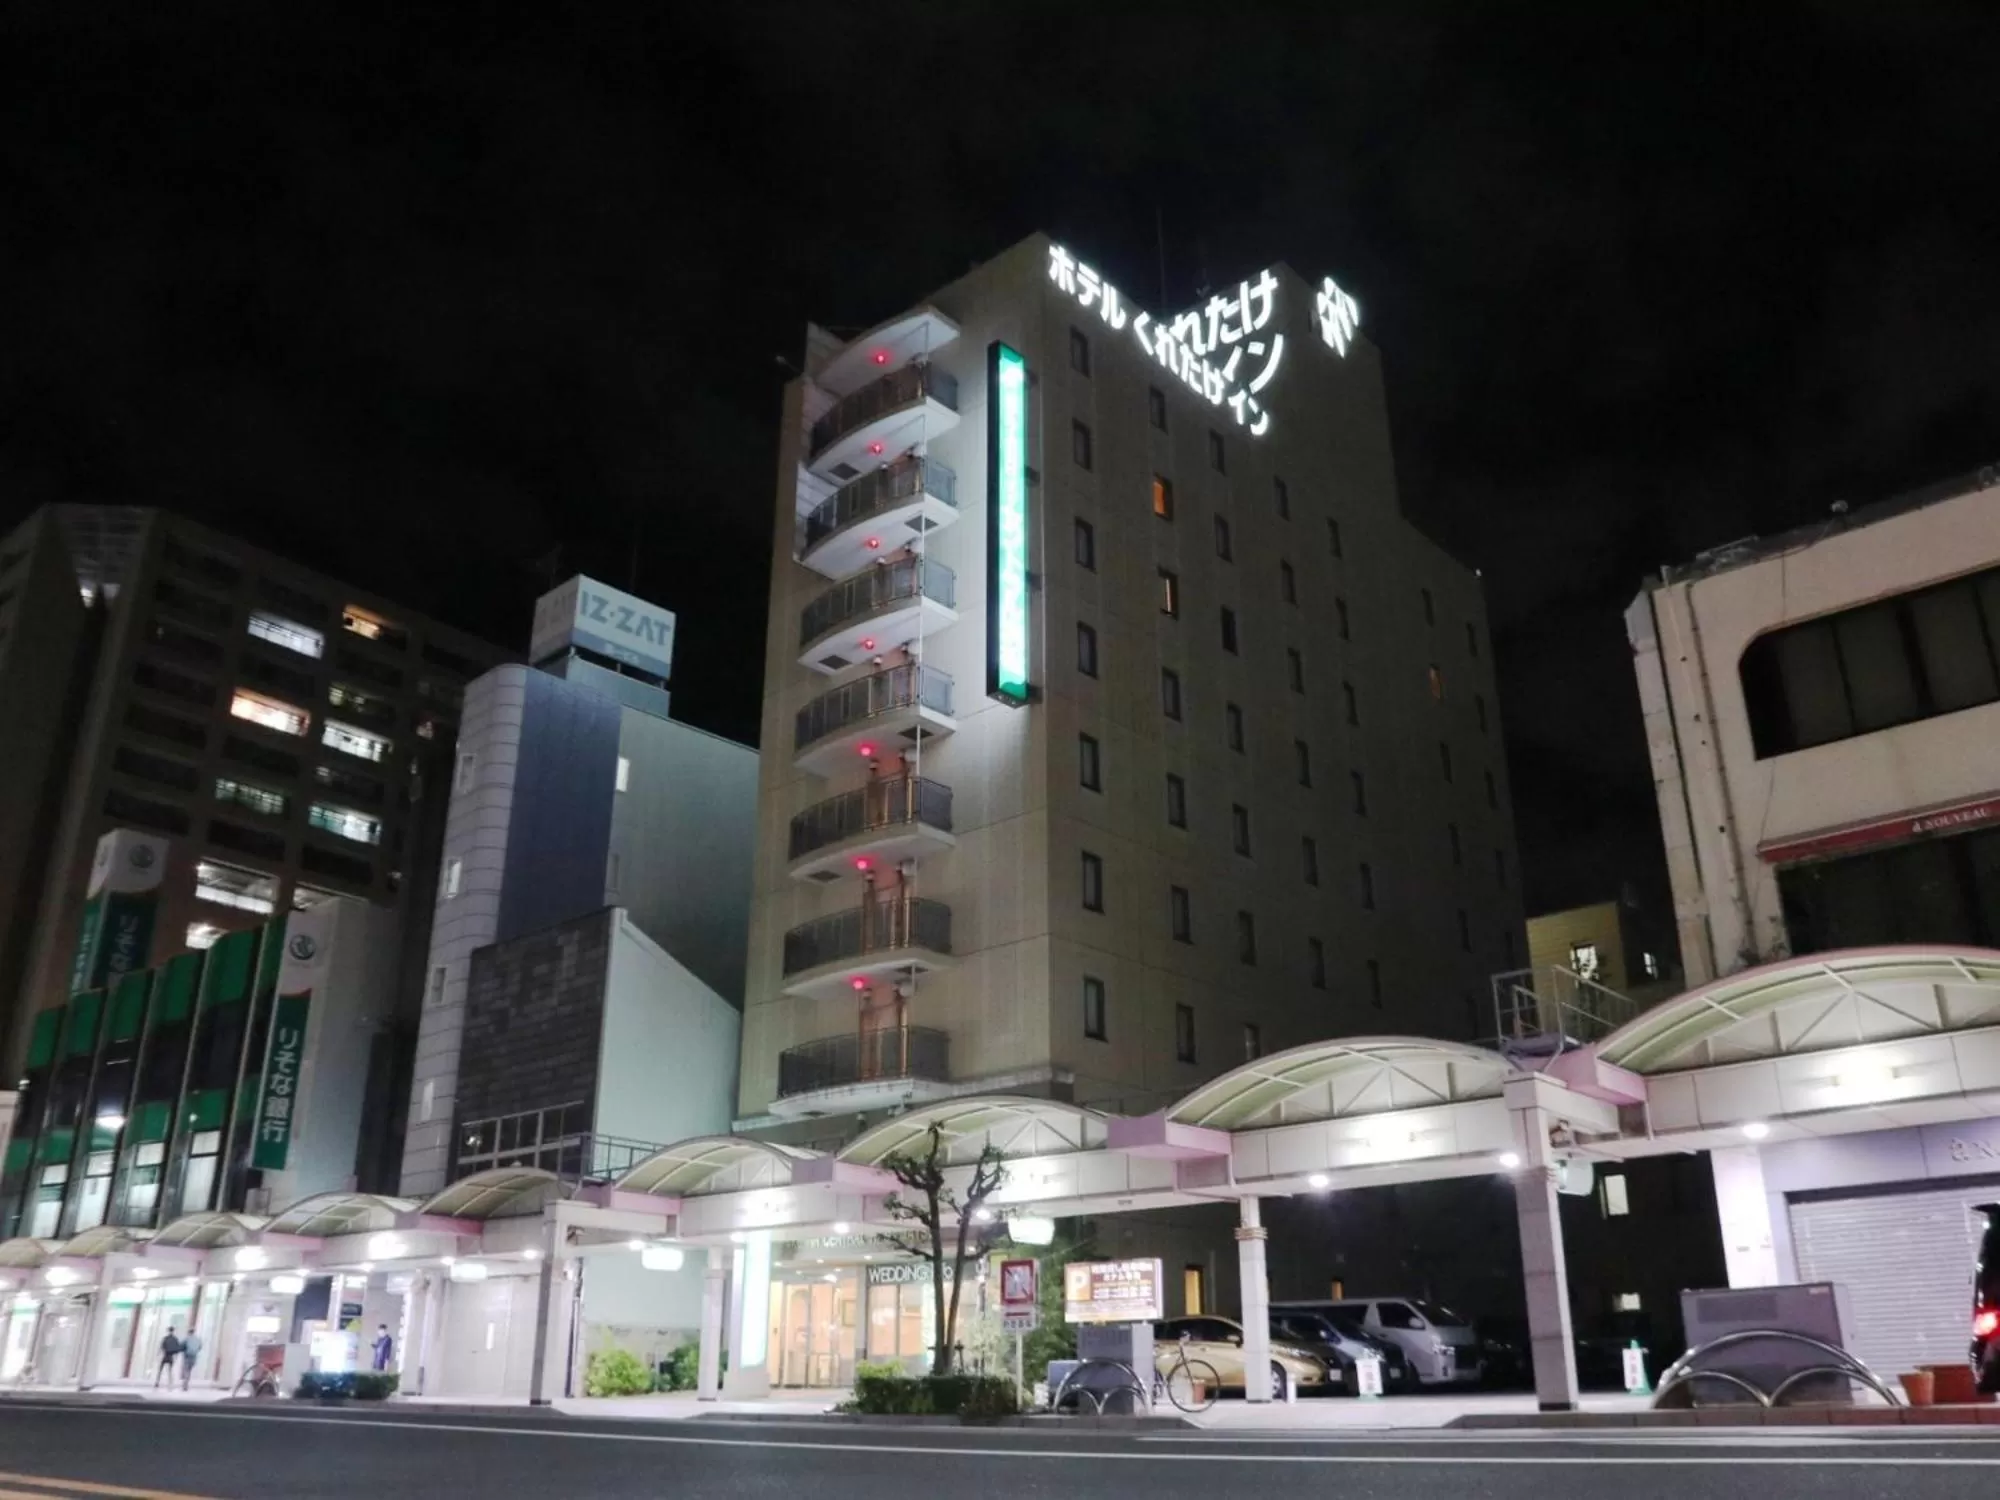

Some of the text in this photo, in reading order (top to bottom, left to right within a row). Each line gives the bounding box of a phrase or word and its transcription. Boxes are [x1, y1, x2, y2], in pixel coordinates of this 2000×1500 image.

[261, 1027, 299, 1143] りそな銀行
[868, 1265, 928, 1284] WEDDING
[1066, 1270, 1086, 1300] P
